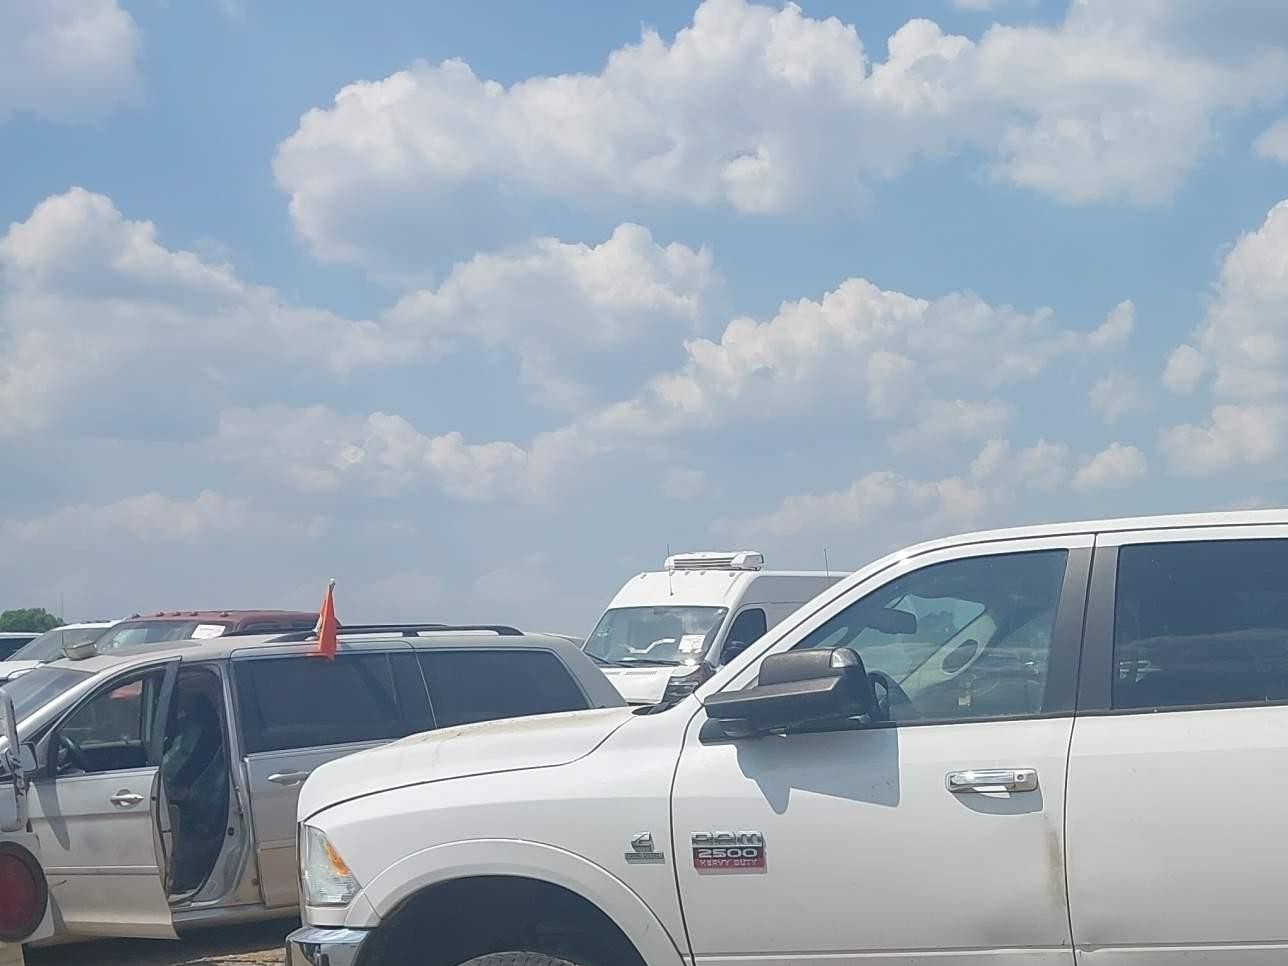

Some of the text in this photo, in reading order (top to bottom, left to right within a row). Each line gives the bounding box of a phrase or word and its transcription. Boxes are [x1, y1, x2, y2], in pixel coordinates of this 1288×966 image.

[690, 831, 763, 847] RAM
[698, 848, 758, 858] 2500
[700, 858, 759, 867] HEAVY DUTY
